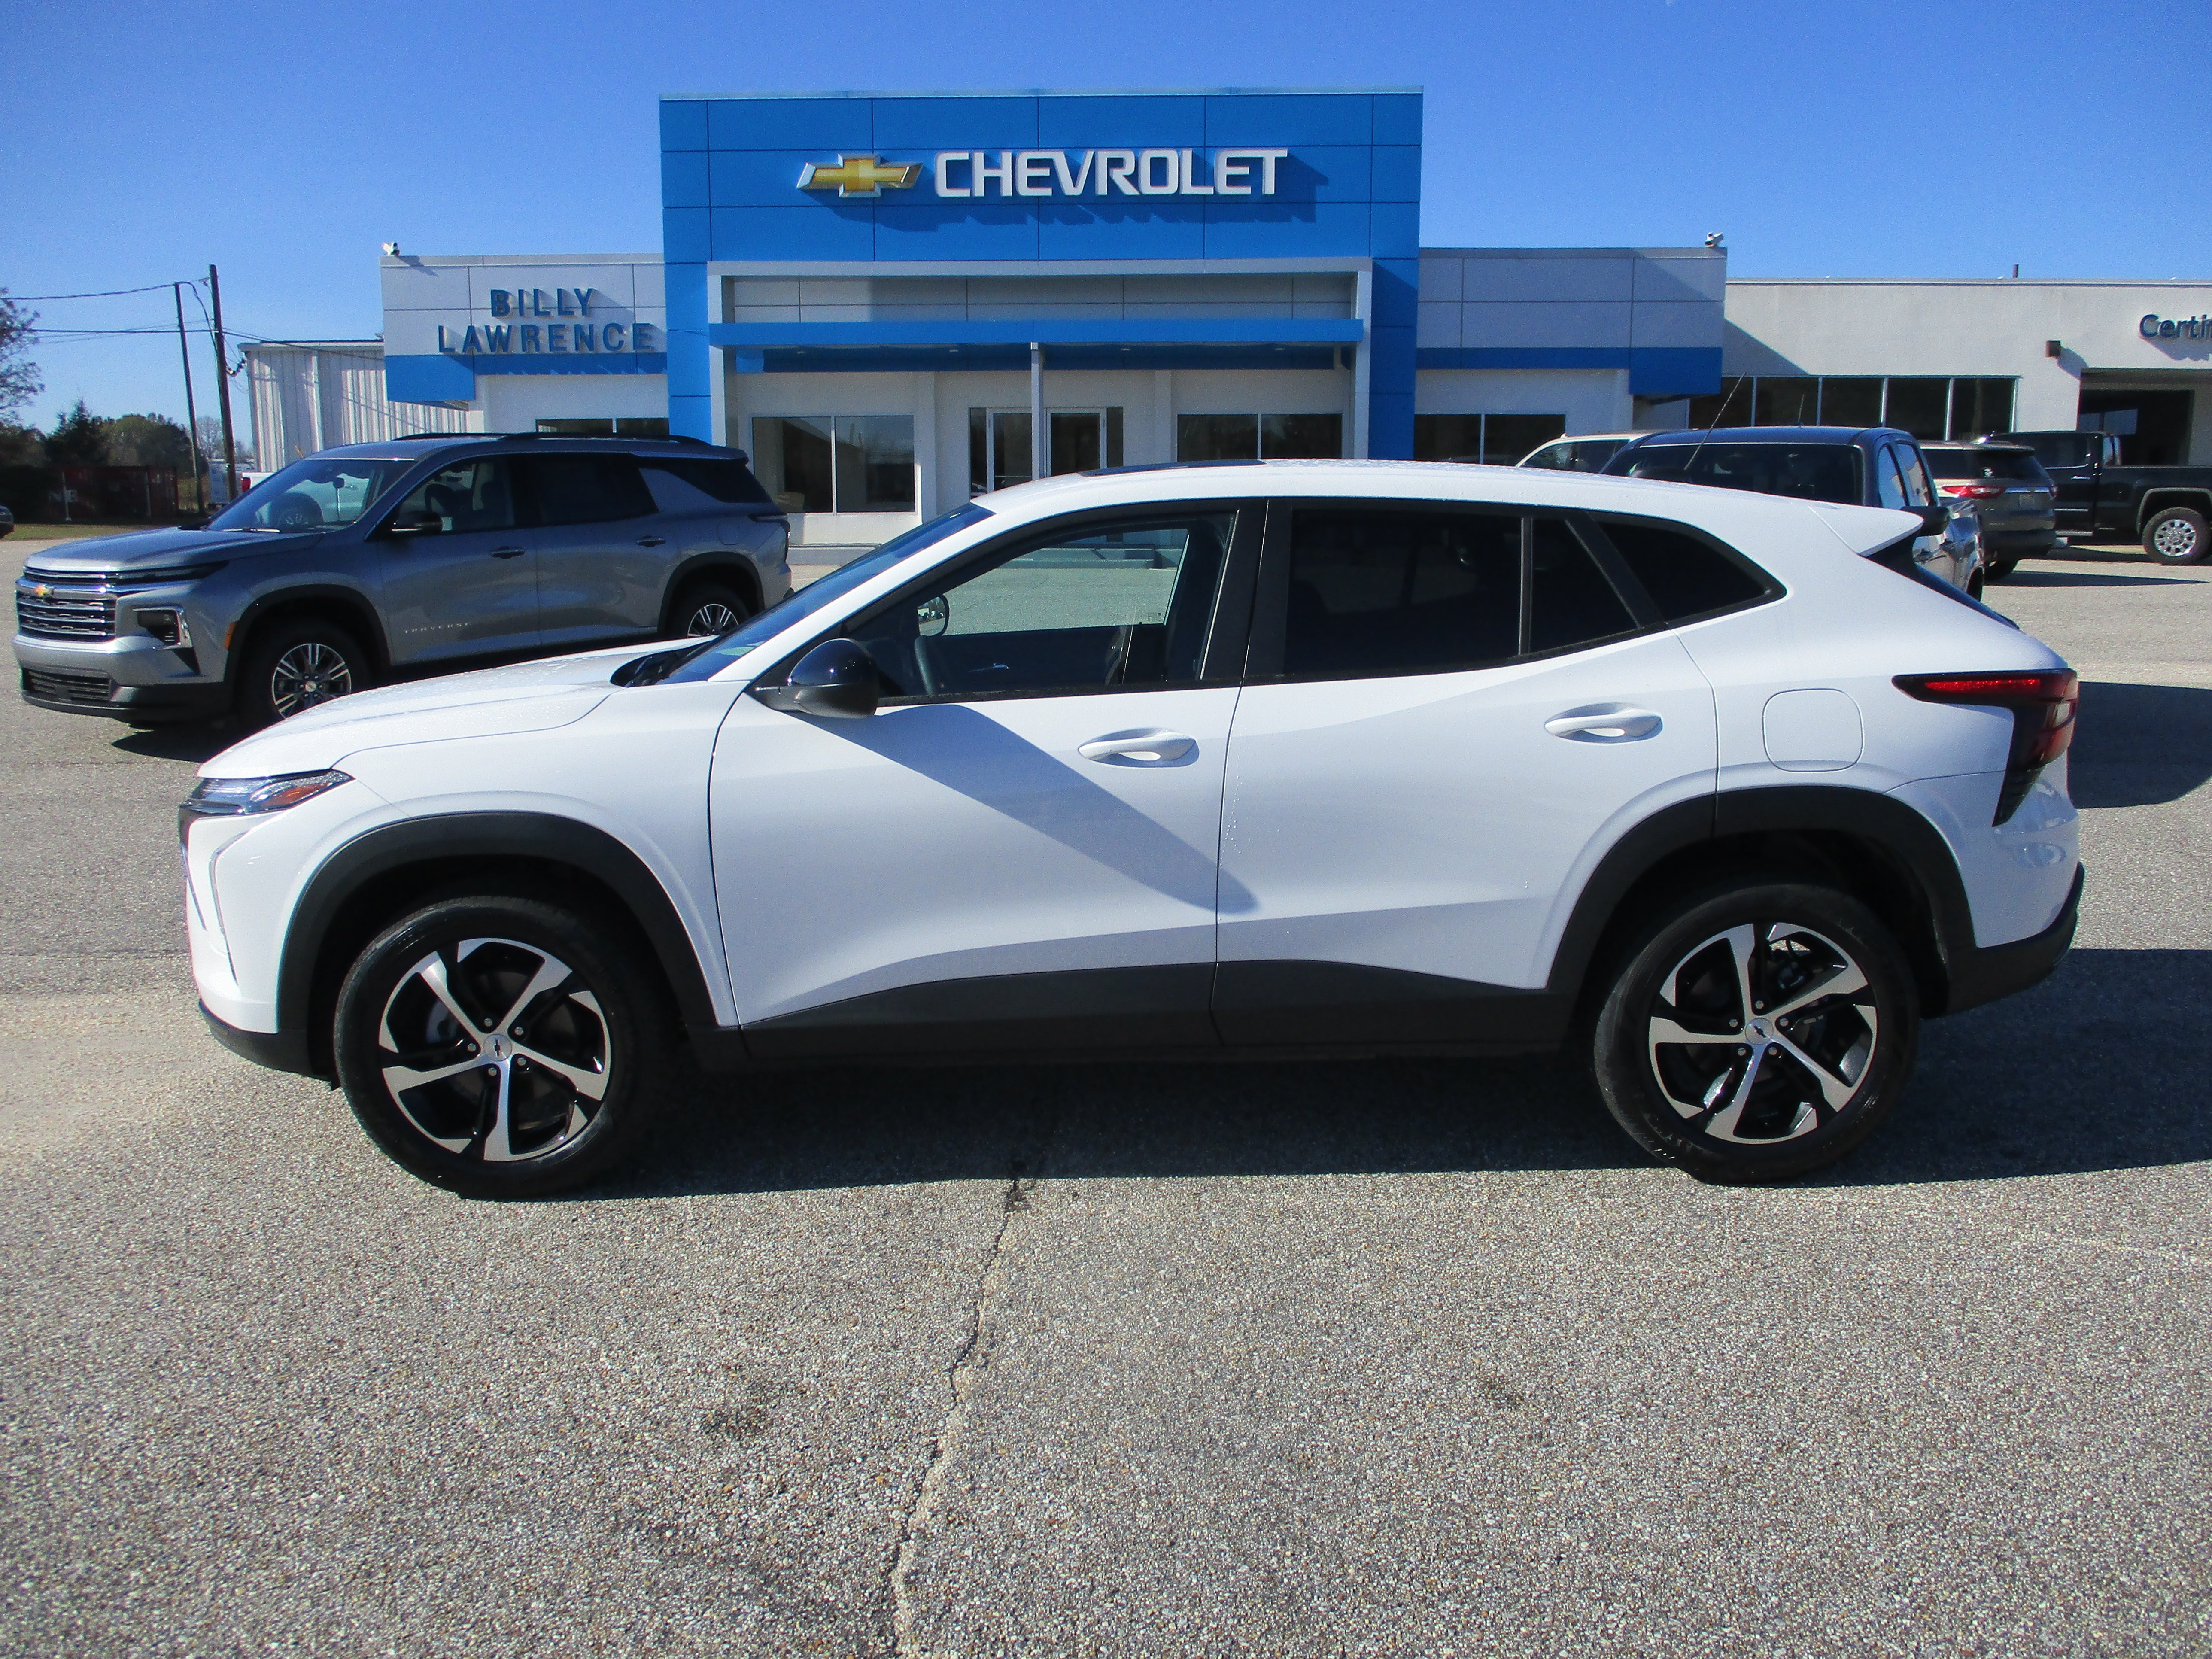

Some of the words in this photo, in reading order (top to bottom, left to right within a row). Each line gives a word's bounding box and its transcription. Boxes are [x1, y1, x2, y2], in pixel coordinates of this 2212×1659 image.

[935, 149, 1288, 198] CHEVROLET
[490, 288, 596, 317] BILLY
[438, 323, 655, 353] LAWRENCE
[2140, 314, 2212, 338] Certi
